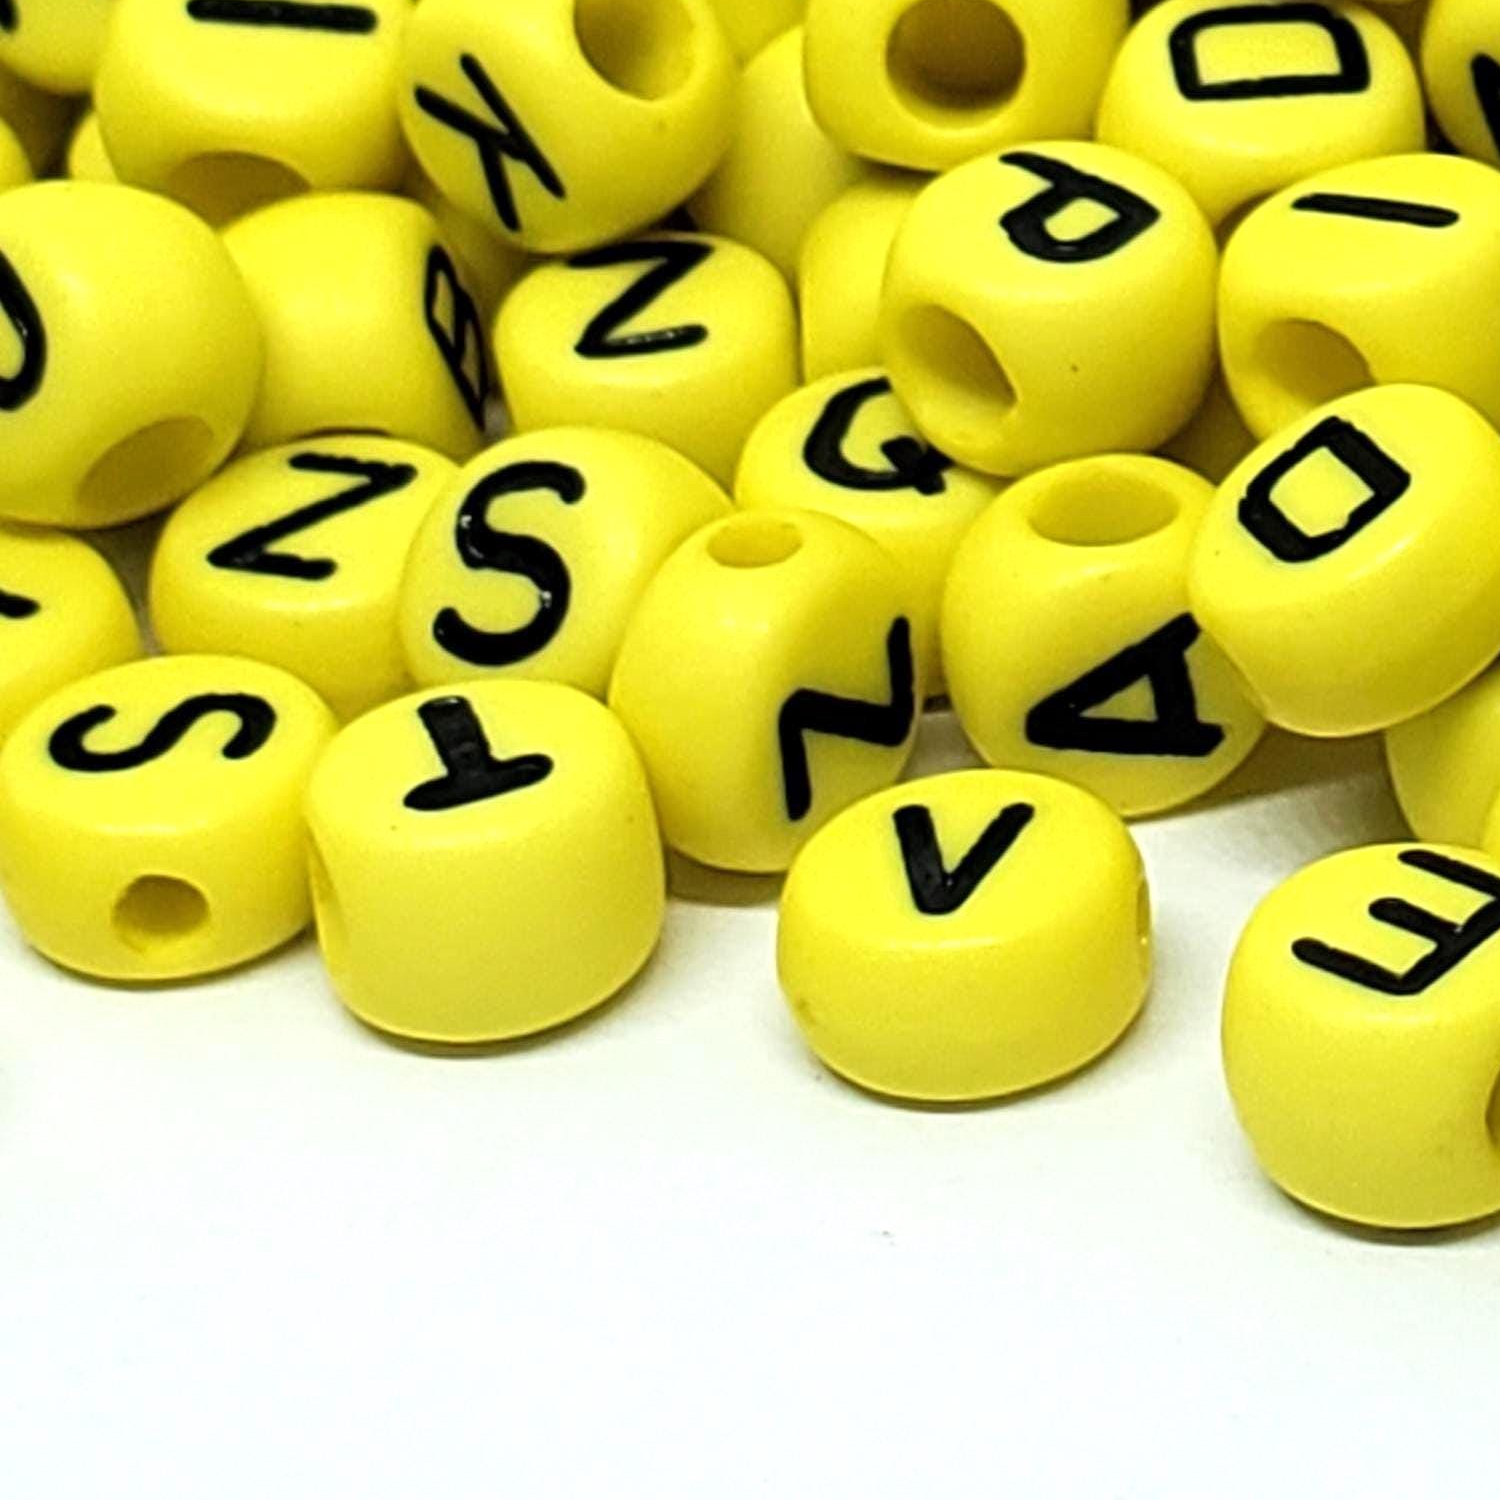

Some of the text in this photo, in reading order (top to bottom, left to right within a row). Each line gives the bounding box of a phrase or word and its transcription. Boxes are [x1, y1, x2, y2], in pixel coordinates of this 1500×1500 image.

[411, 52, 568, 235] K
[999, 150, 1161, 265] P
[431, 460, 587, 669] S
[47, 691, 279, 775] S
[1022, 610, 1228, 761] A
[401, 694, 556, 814] T
[891, 801, 1038, 917] V
